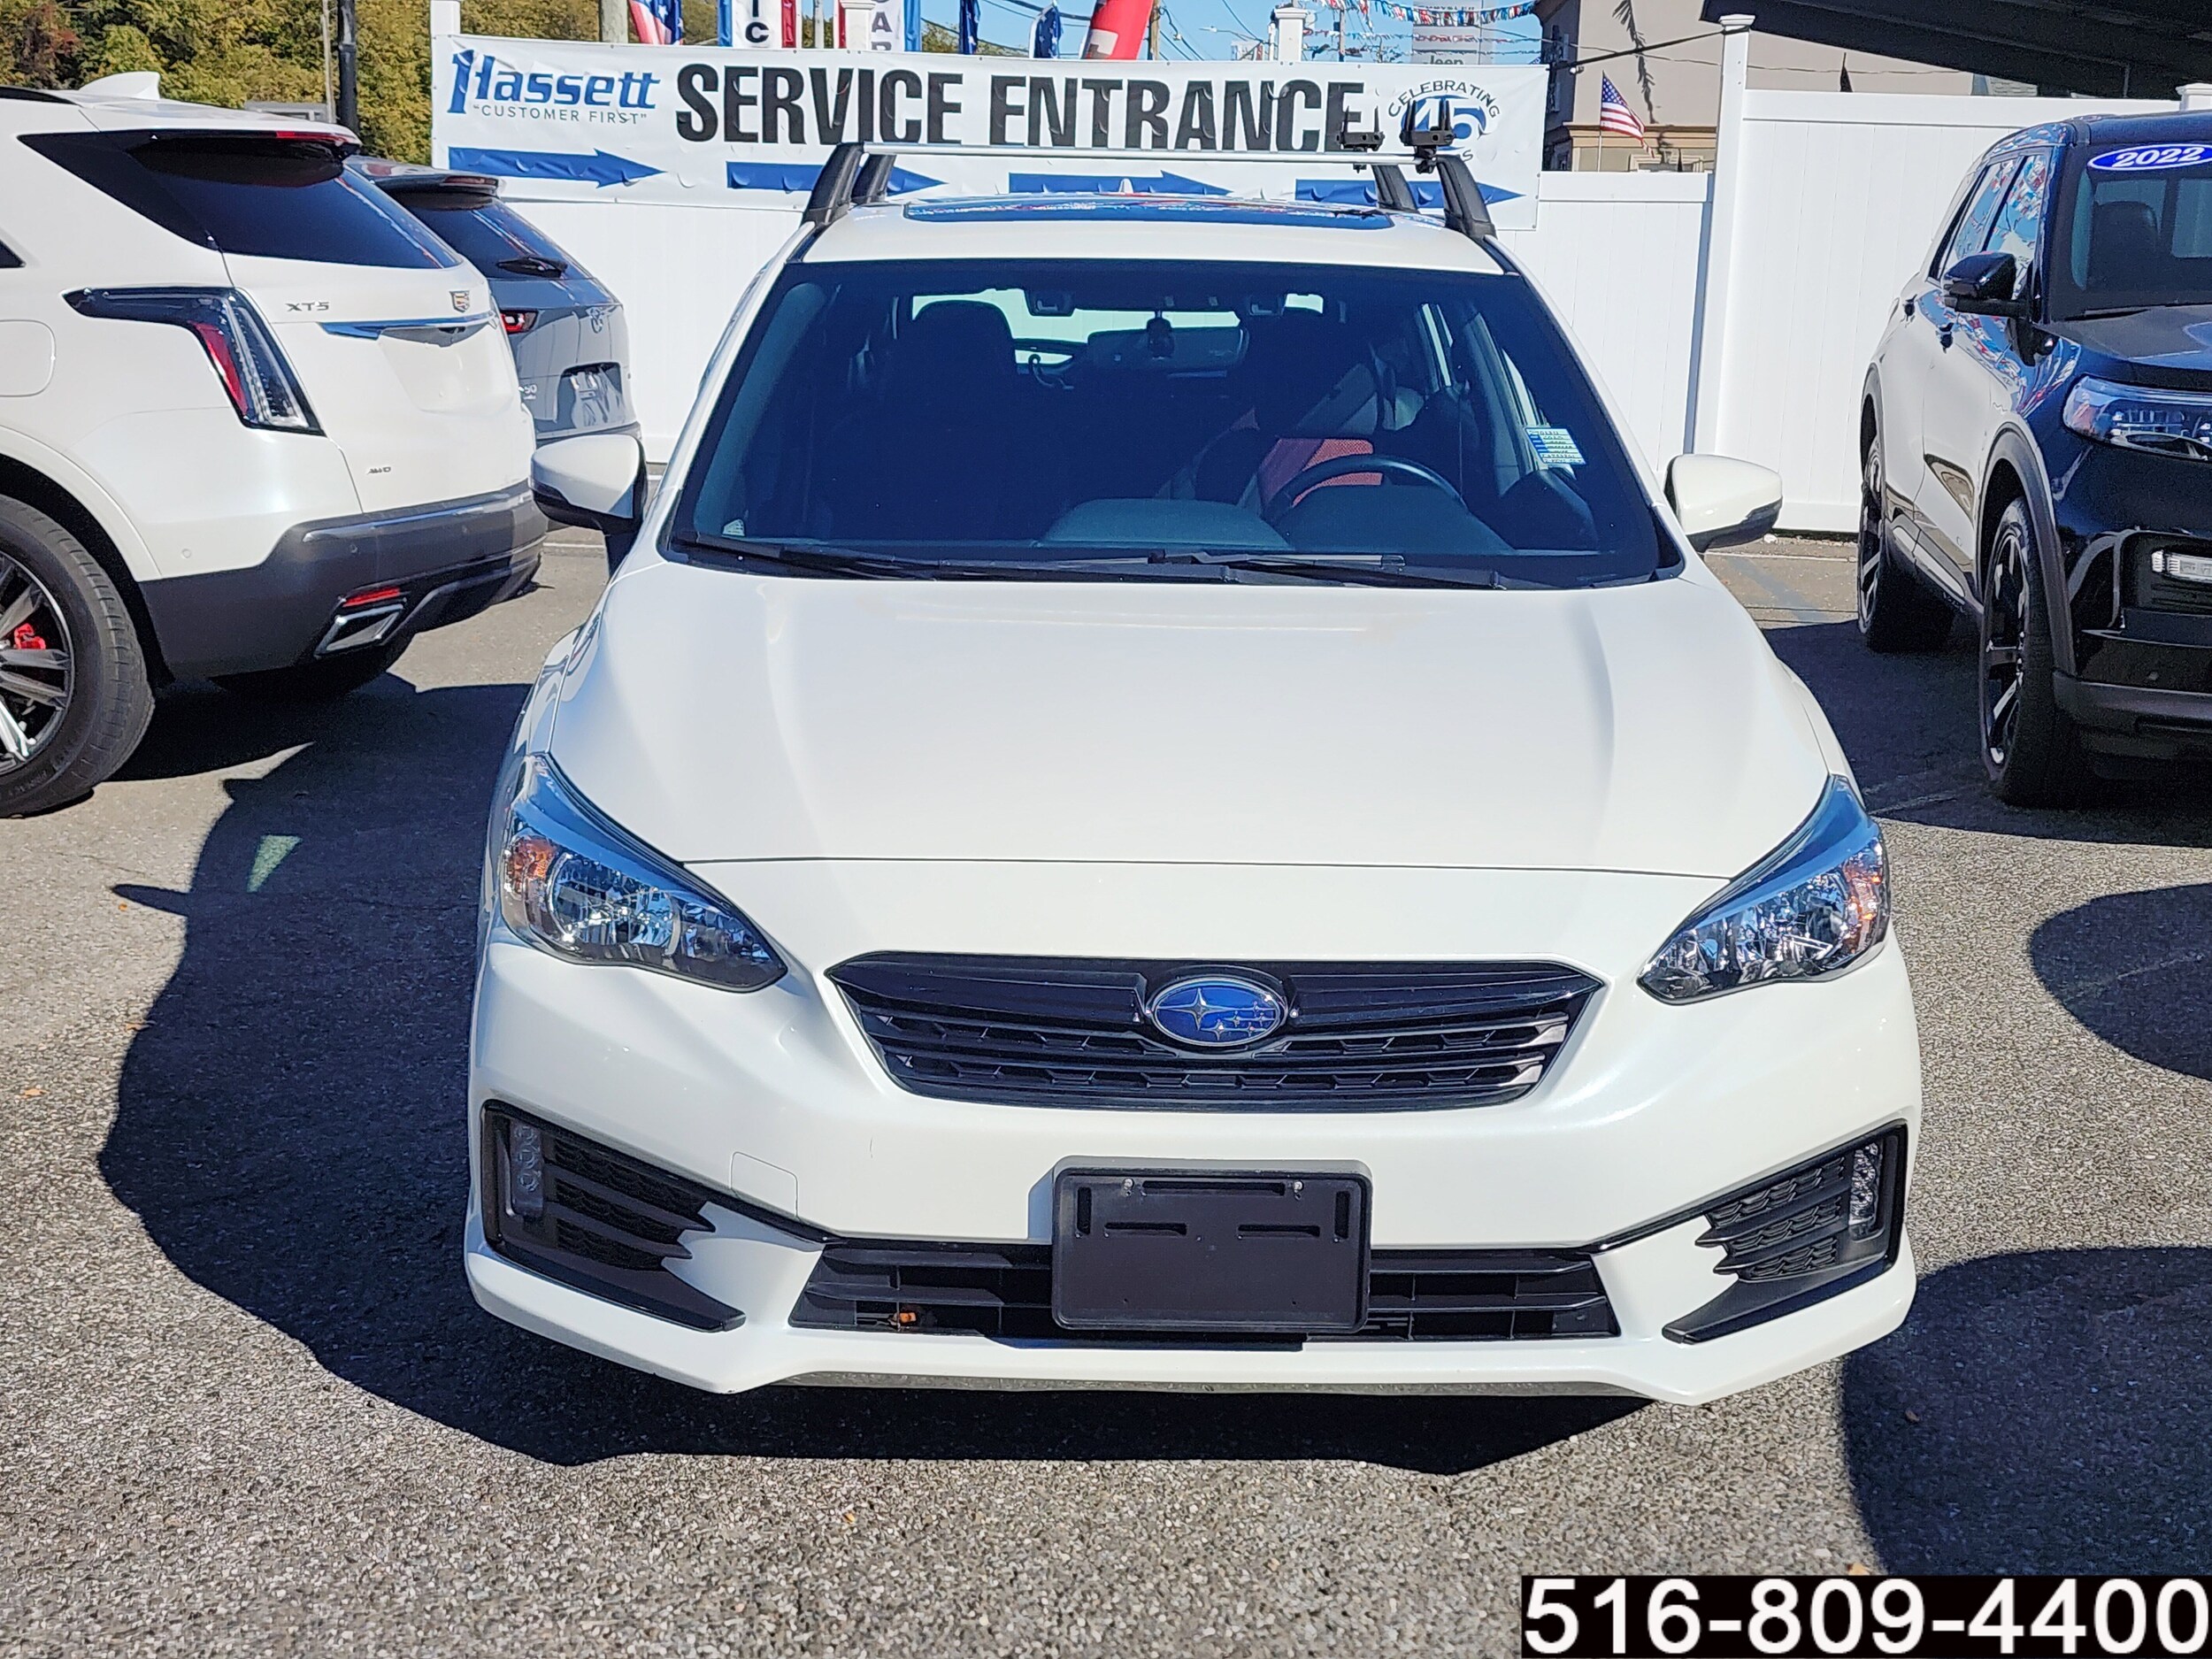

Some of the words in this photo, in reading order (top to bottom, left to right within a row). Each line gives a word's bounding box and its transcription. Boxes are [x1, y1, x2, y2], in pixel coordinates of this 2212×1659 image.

[447, 50, 661, 114] Hassett
[1388, 80, 1501, 119] CELEBRATING
[676, 63, 964, 146] SERVICE
[988, 74, 1365, 153] ENTRANCE
[2112, 147, 2206, 168] 2022
[285, 302, 330, 312] XT5
